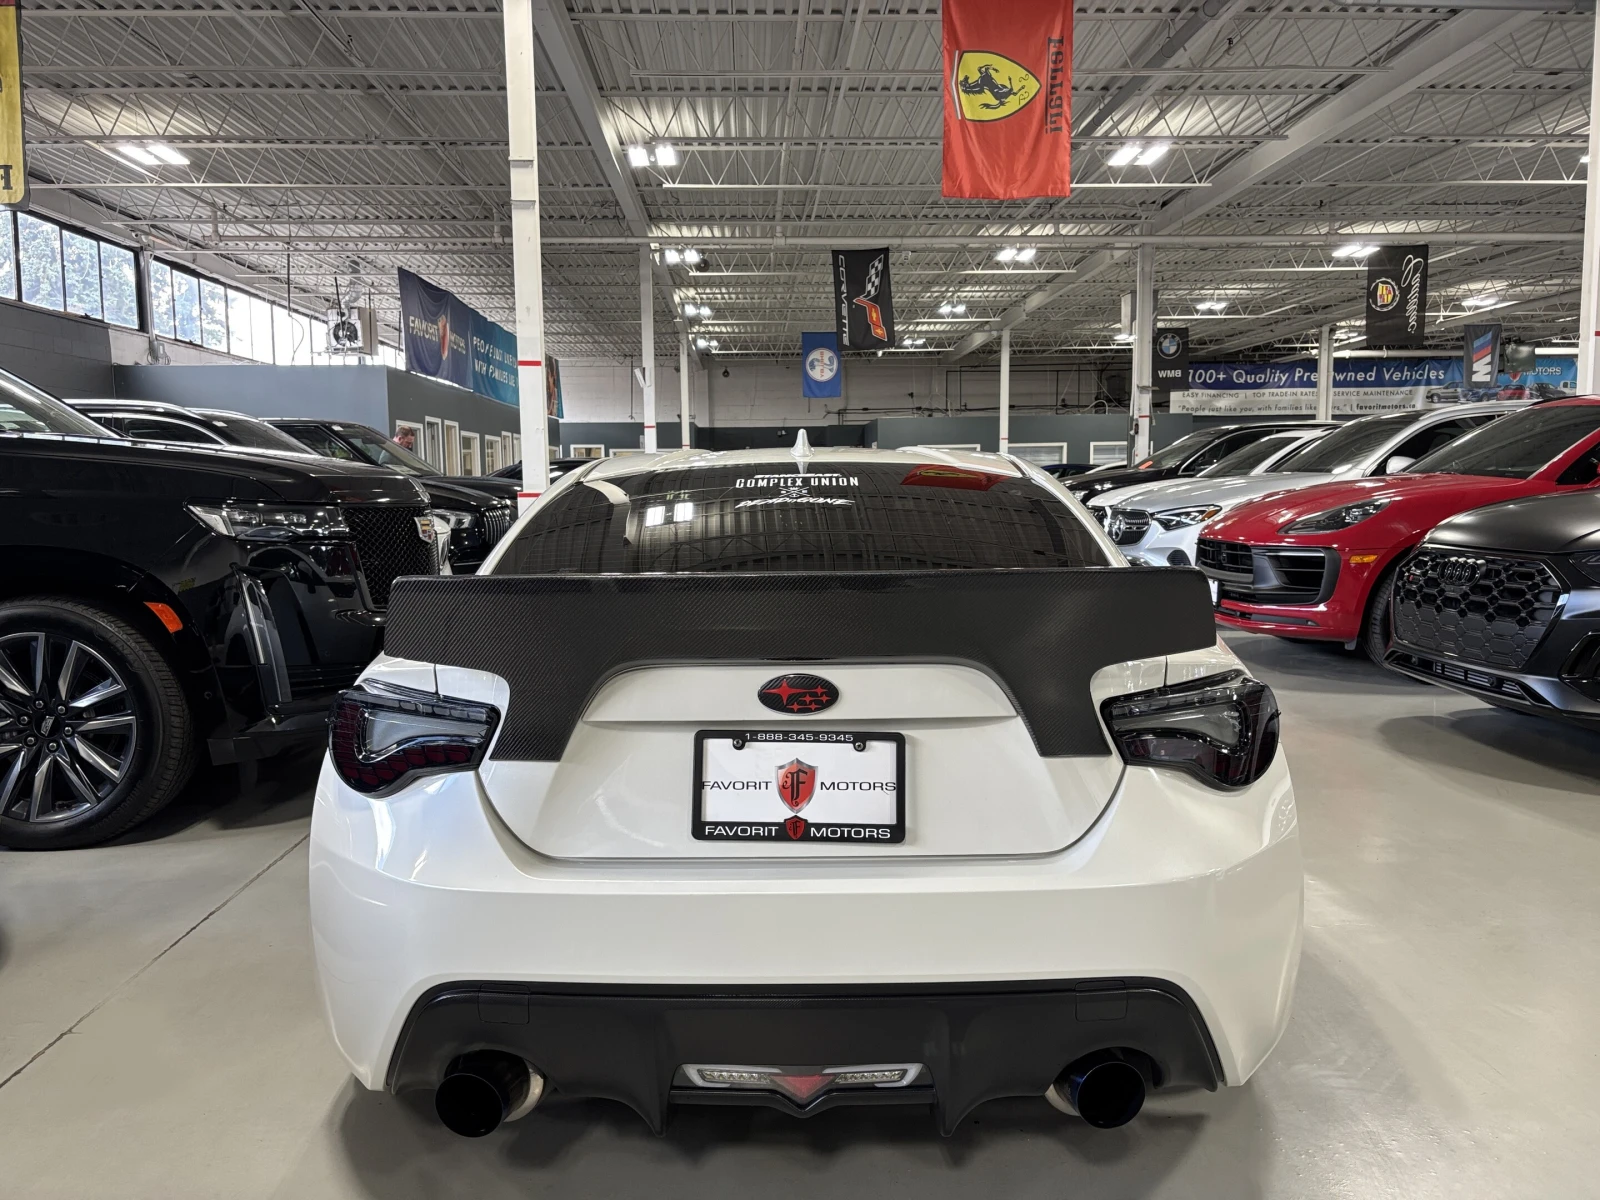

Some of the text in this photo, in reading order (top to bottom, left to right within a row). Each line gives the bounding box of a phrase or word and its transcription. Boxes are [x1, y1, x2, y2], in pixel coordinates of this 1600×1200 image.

[838, 254, 850, 347] CORVETTE
[1232, 367, 1289, 386] Quality
[1383, 364, 1446, 382] Vehicles
[1182, 391, 1199, 399] EASY
[1200, 391, 1240, 399] FINANCING
[1268, 390, 1298, 398] TRADE-IN
[1333, 390, 1360, 398] SERVICE
[1362, 389, 1413, 397] MAINTENANCE
[1208, 405, 1222, 413] just
[1224, 404, 1237, 412] like
[1274, 403, 1302, 411] families
[1356, 402, 1416, 411] favoritmotors.ca
[735, 476, 859, 488] COMPLEX UNION
[745, 733, 854, 742] 1-888-345-9345
[702, 780, 772, 791] FAVORIT
[820, 781, 897, 792] MOTORS
[705, 825, 779, 837] FAVORIT
[810, 826, 891, 839] MOTORS
